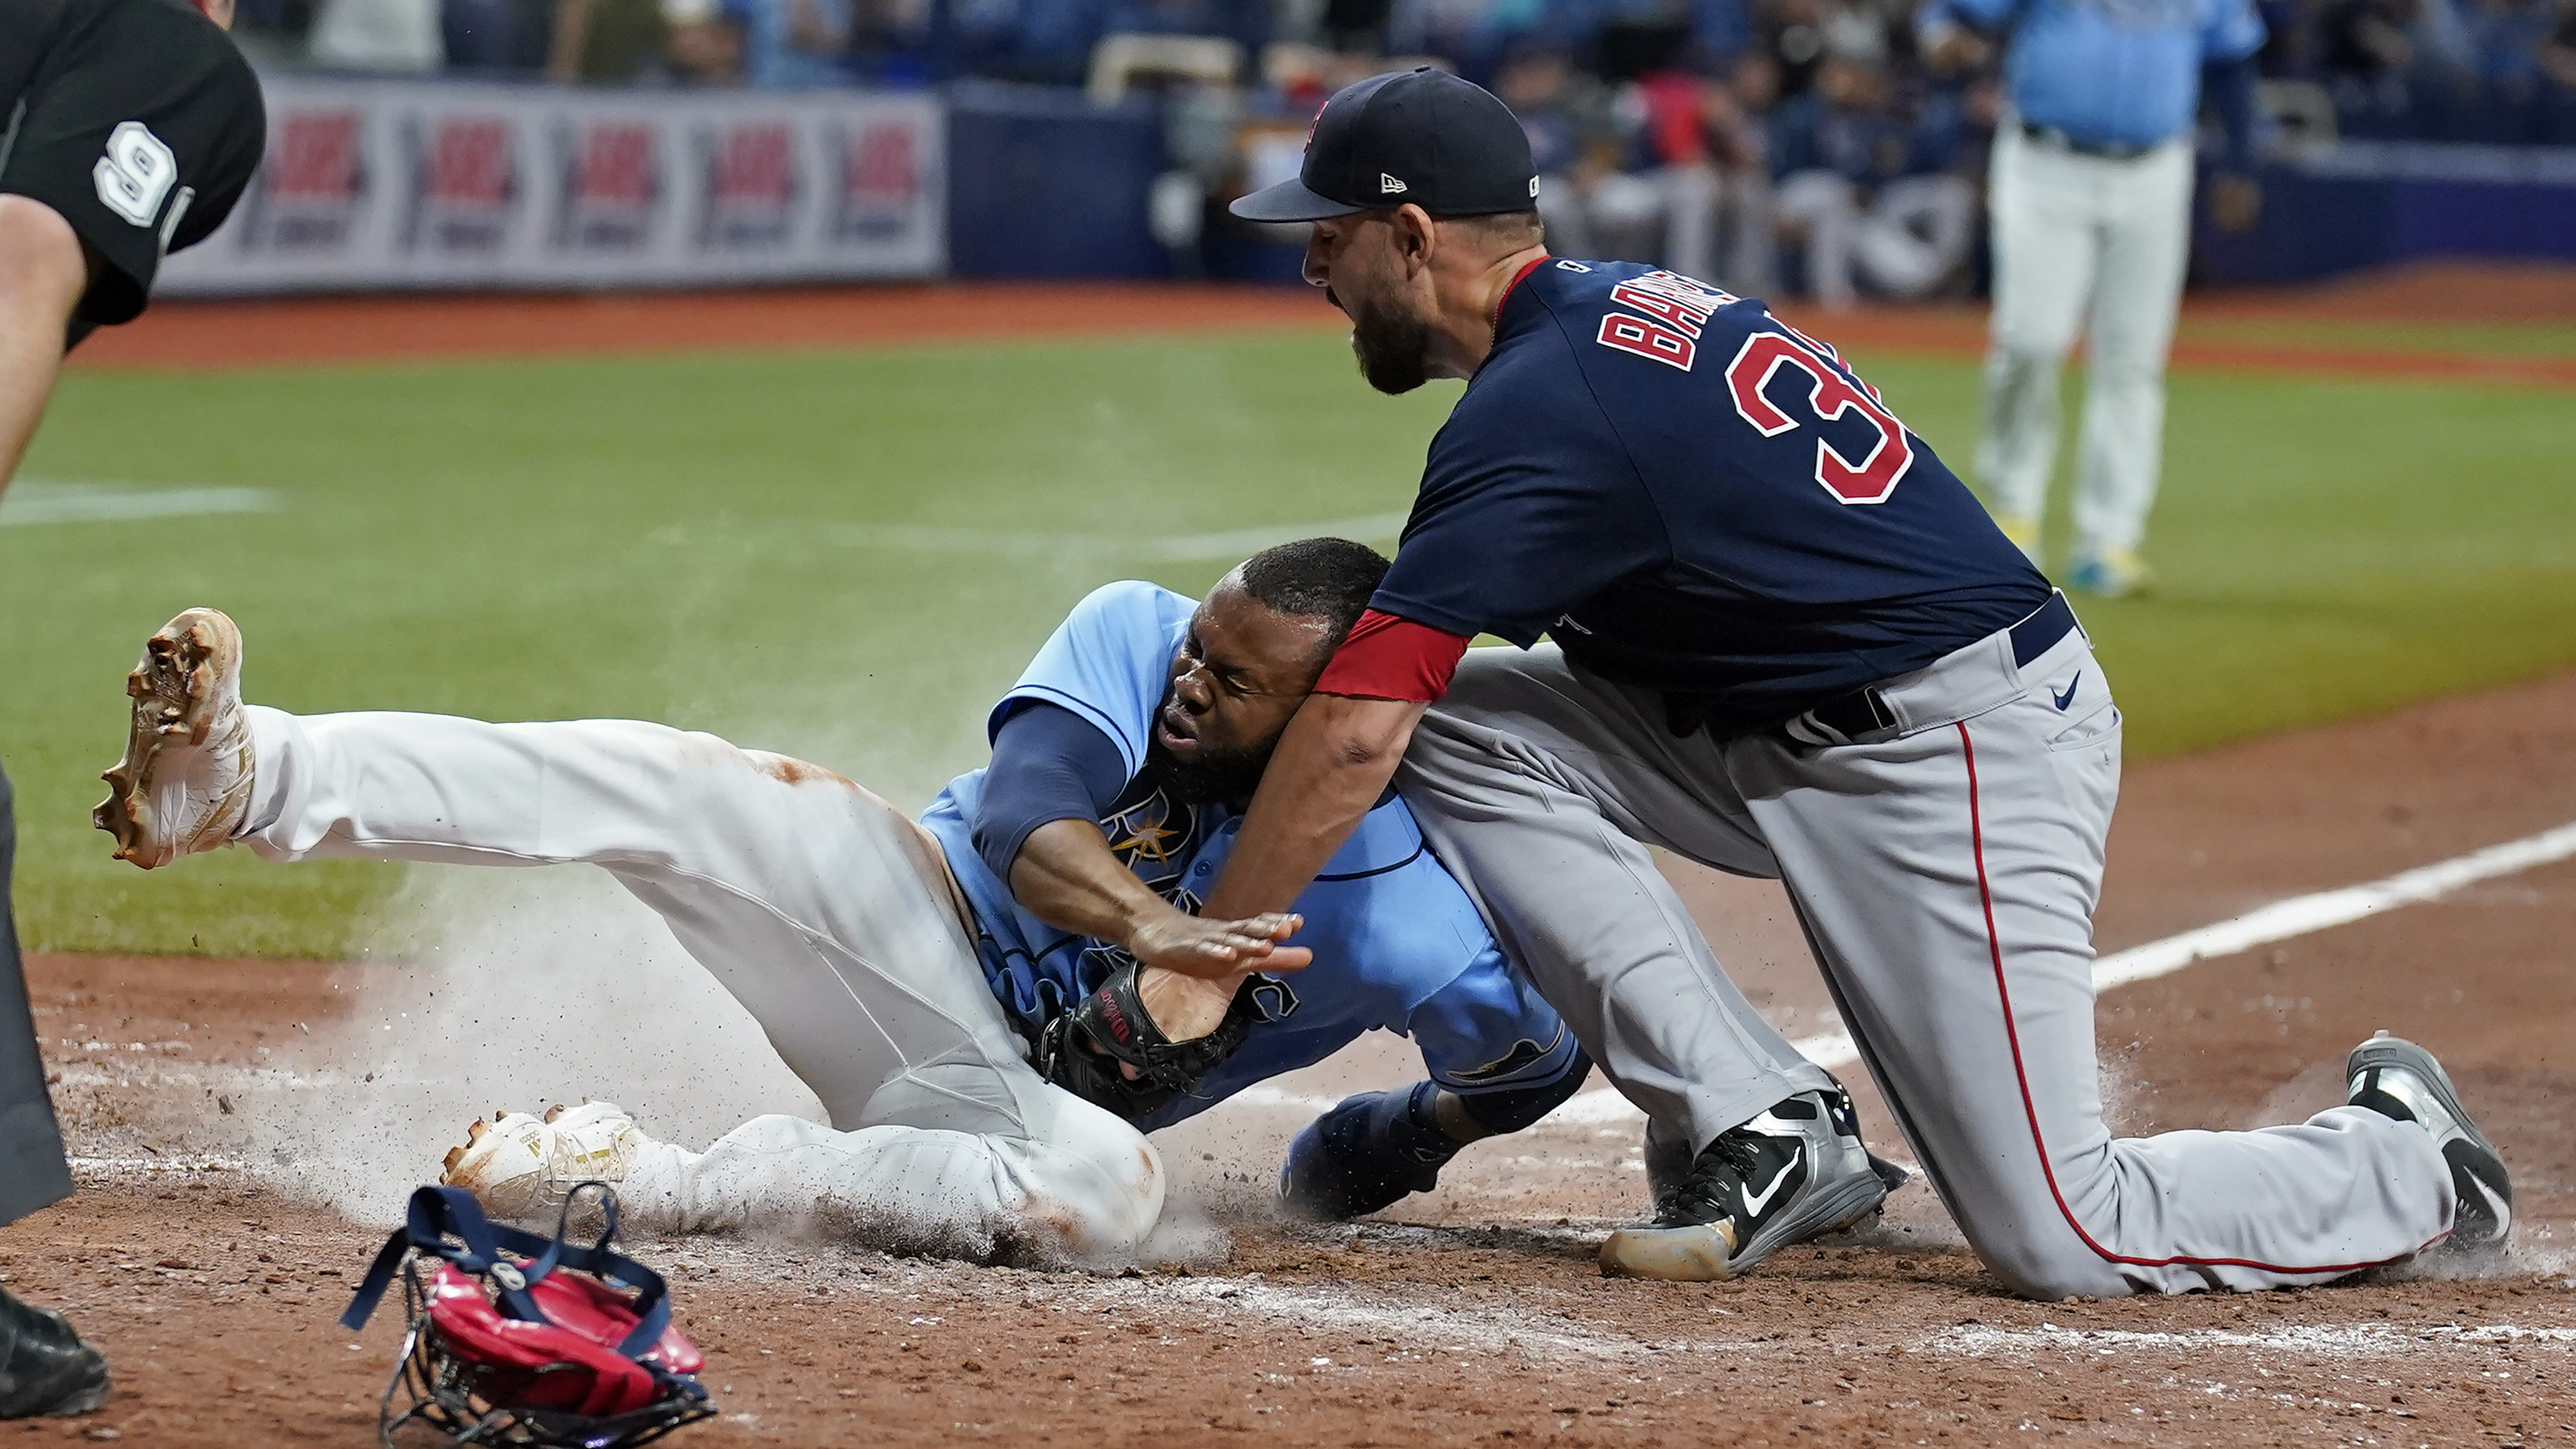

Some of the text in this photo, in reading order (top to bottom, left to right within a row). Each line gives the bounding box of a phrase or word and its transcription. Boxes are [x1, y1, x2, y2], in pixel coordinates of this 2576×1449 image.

[92, 121, 178, 227] 9
[1725, 310, 1919, 505] 3
[519, 1129, 540, 1145] adidas
